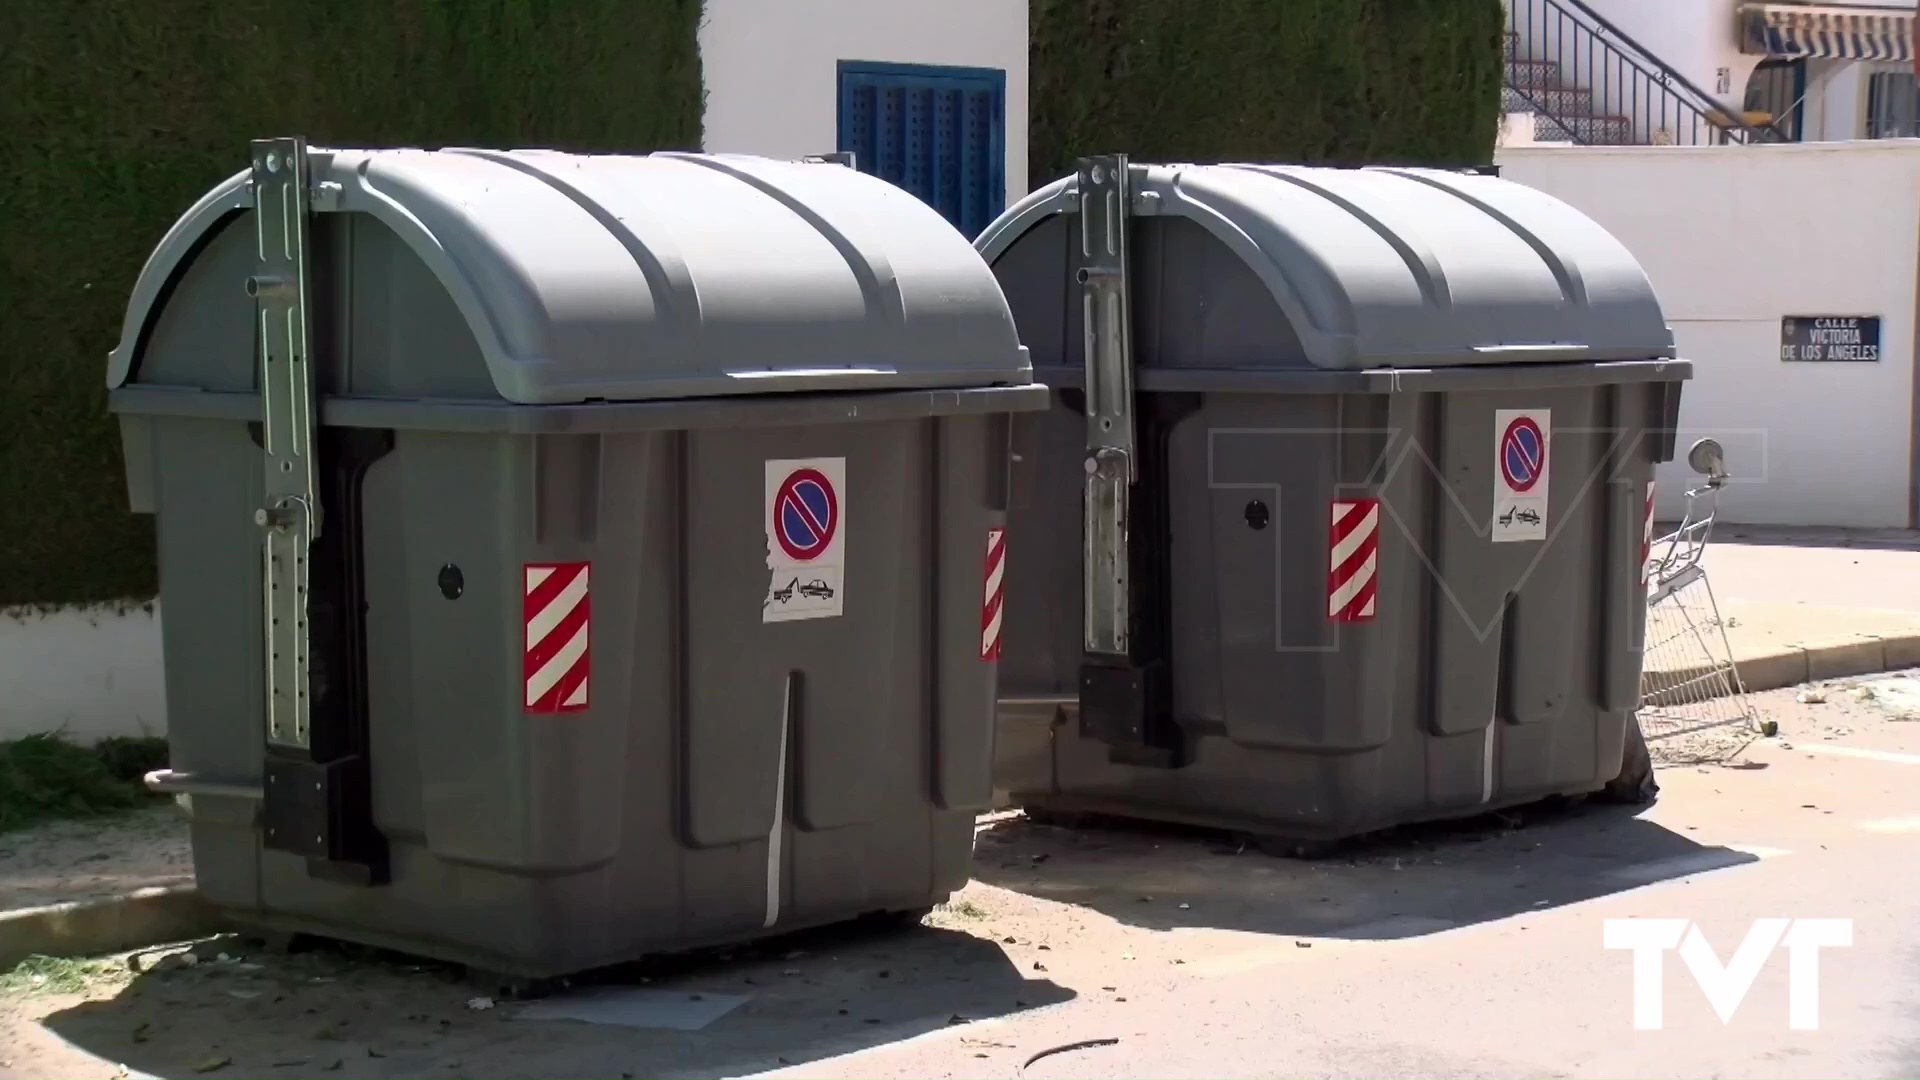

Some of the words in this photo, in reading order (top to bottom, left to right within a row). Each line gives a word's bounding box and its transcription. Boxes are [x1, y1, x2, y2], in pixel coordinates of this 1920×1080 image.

[1814, 318, 1857, 328] CALLE
[1809, 328, 1861, 344] VICTORIA
[1782, 345, 1796, 360] DE
[1801, 345, 1822, 360] LOS
[1826, 345, 1878, 360] ANGELES
